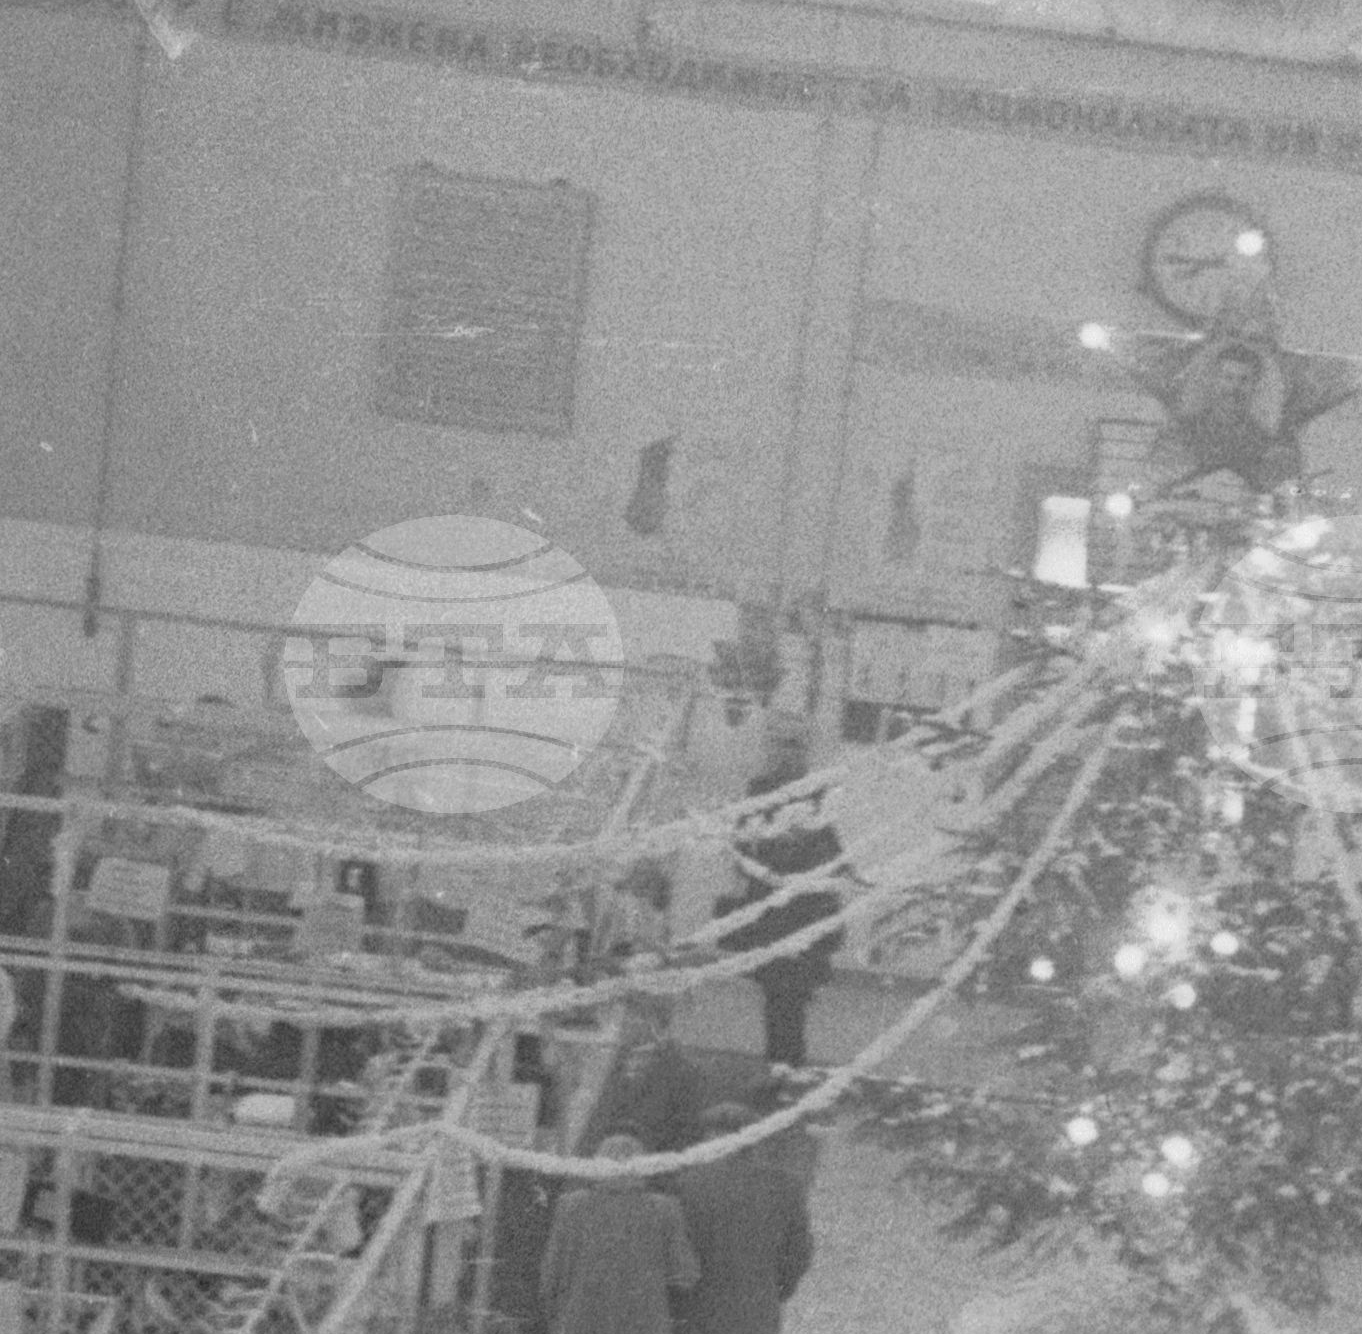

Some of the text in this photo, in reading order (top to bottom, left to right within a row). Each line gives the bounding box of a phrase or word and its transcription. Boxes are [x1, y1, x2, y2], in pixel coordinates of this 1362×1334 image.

[272, 3, 488, 63] ЖИЗНЕНА
[509, 33, 847, 107] НЕОБХОДИМОСТ
[860, 76, 912, 113] ЗА
